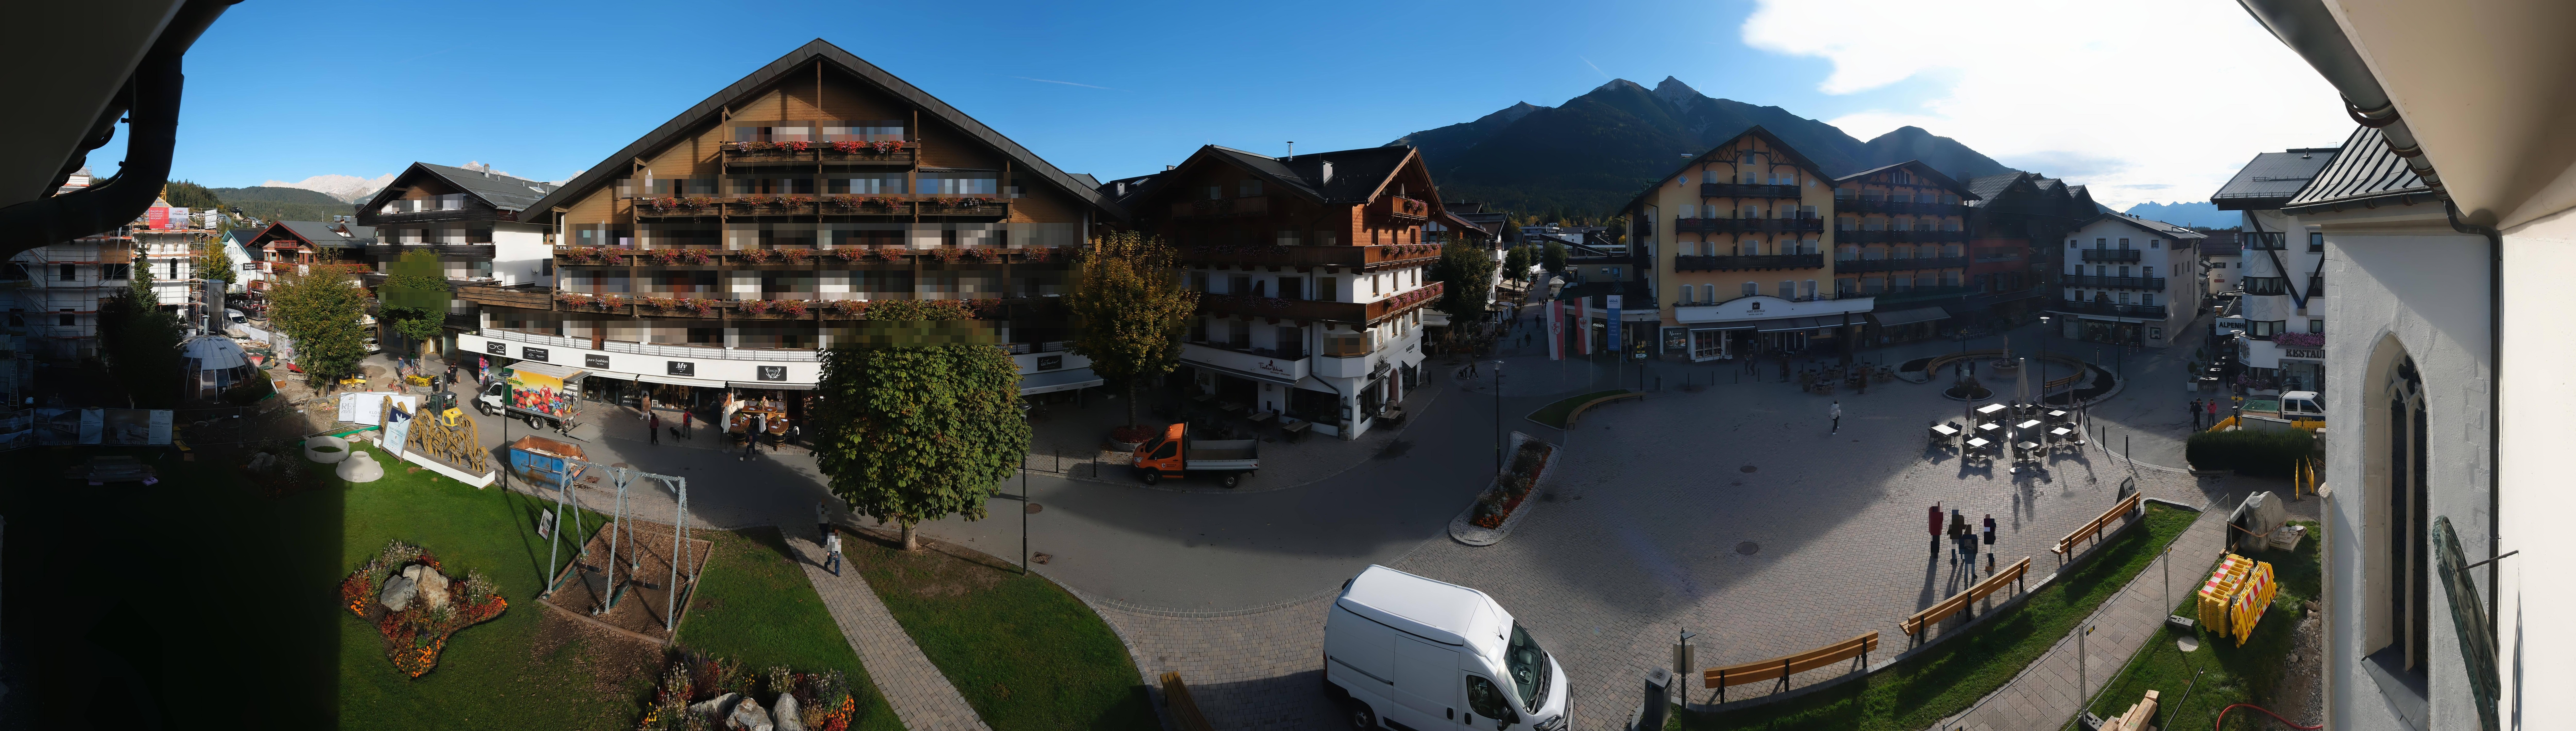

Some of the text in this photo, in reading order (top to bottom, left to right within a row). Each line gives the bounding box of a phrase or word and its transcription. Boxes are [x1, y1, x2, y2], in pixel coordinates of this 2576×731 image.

[1406, 344, 1414, 352] SAILER
[676, 362, 687, 372] My
[1376, 365, 1389, 378] RESTAURANT
[389, 426, 401, 435] DEAFLYMPICS
